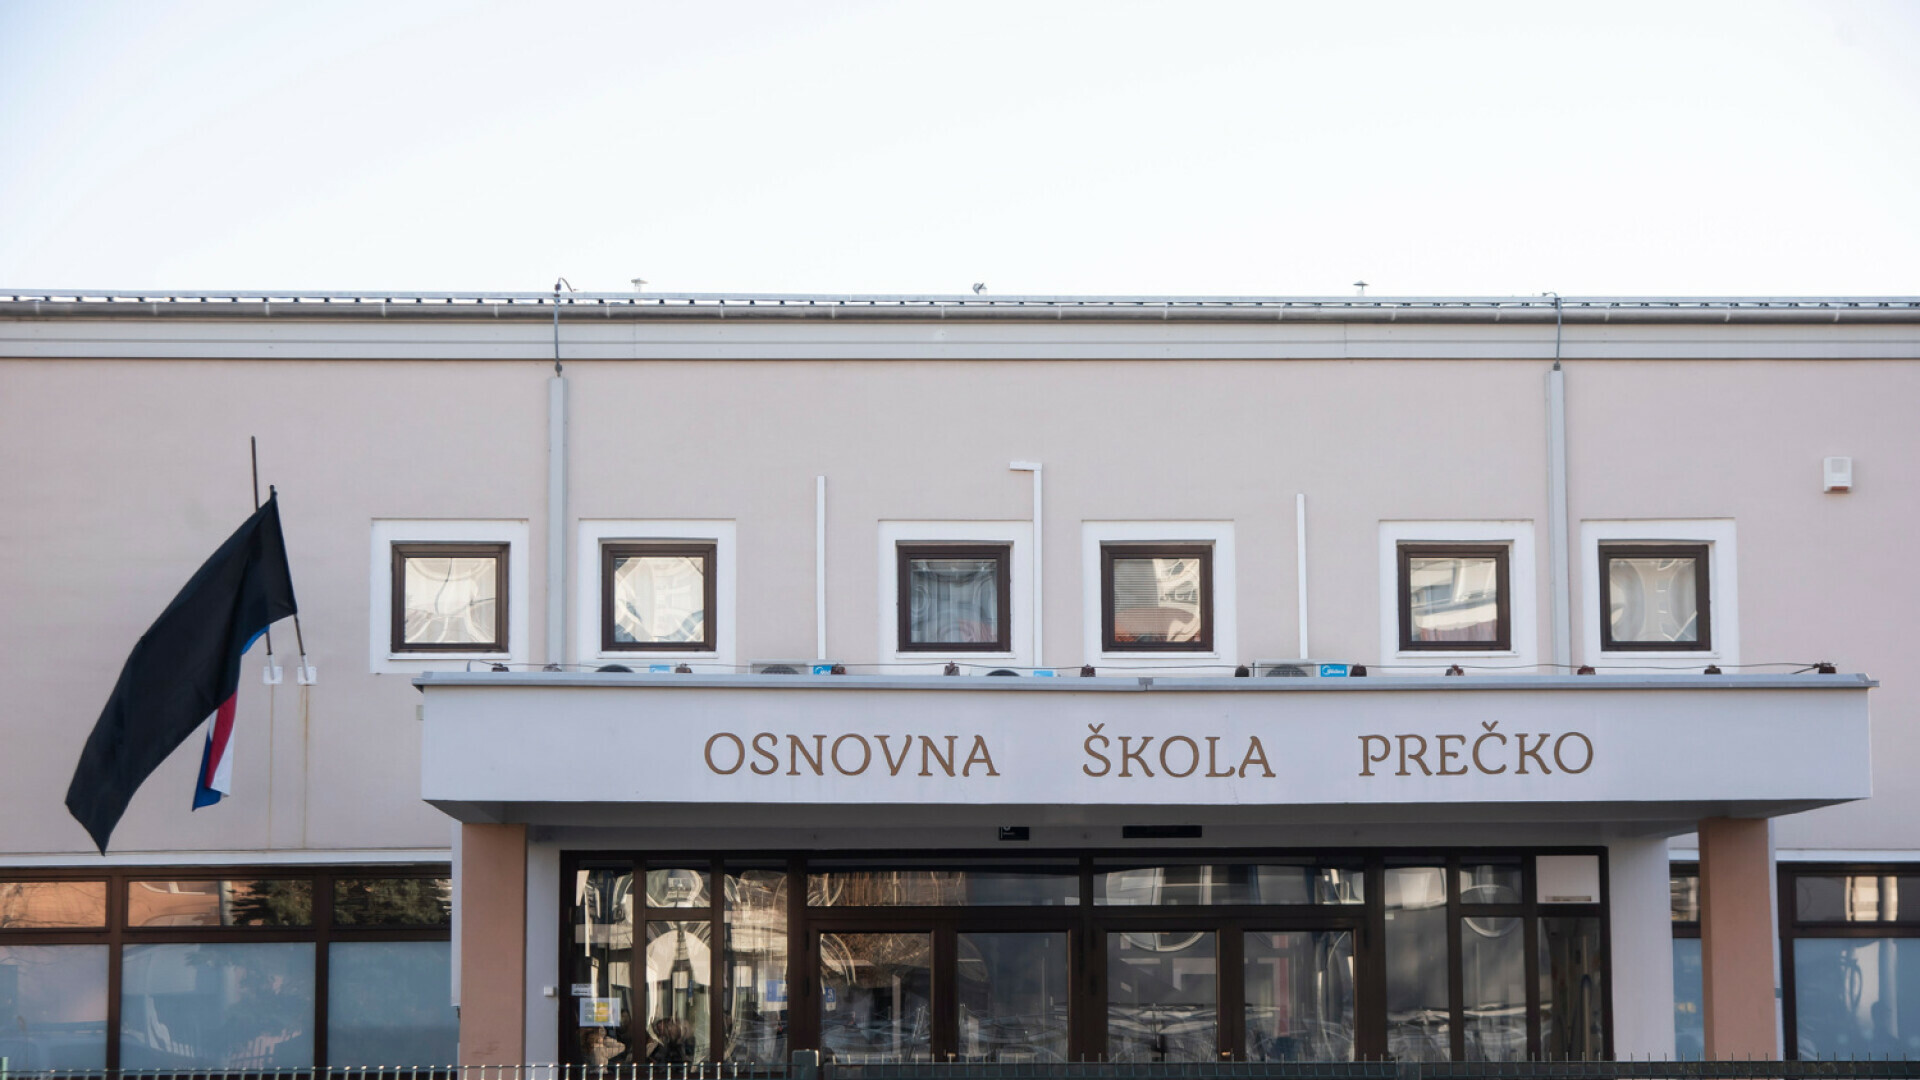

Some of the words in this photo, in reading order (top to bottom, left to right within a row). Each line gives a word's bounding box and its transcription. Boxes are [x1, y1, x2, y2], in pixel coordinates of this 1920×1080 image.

[704, 732, 1000, 777] OSNOVNA
[1082, 723, 1276, 778] ŠKOLA
[1359, 720, 1593, 777] PREČKO
